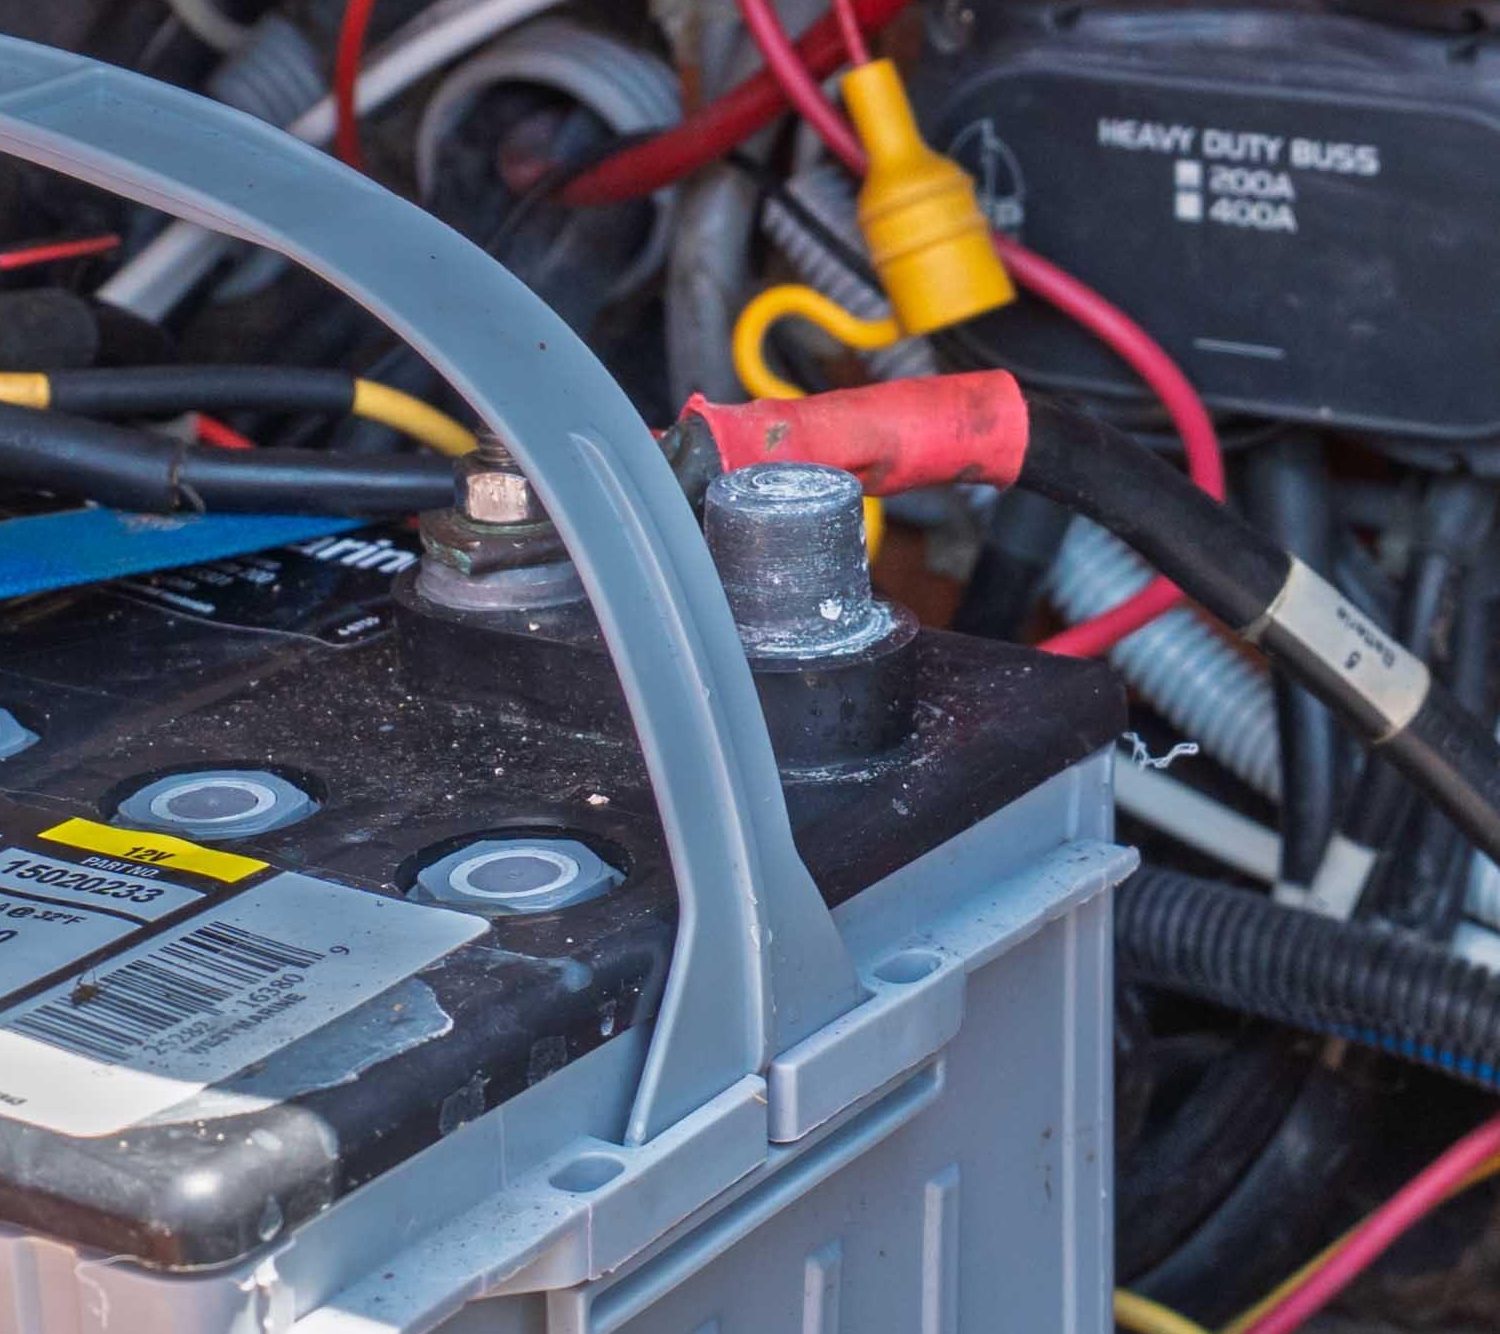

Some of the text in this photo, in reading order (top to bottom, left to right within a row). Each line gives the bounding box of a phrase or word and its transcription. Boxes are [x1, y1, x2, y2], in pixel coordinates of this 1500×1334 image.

[1098, 117, 1381, 177] HEAVY DUTY BUSS
[1209, 165, 1296, 202] 200A
[1208, 197, 1299, 235] 400A
[82, 854, 129, 873] PART
[125, 845, 176, 864] 12V
[1, 858, 166, 904] 15020233
